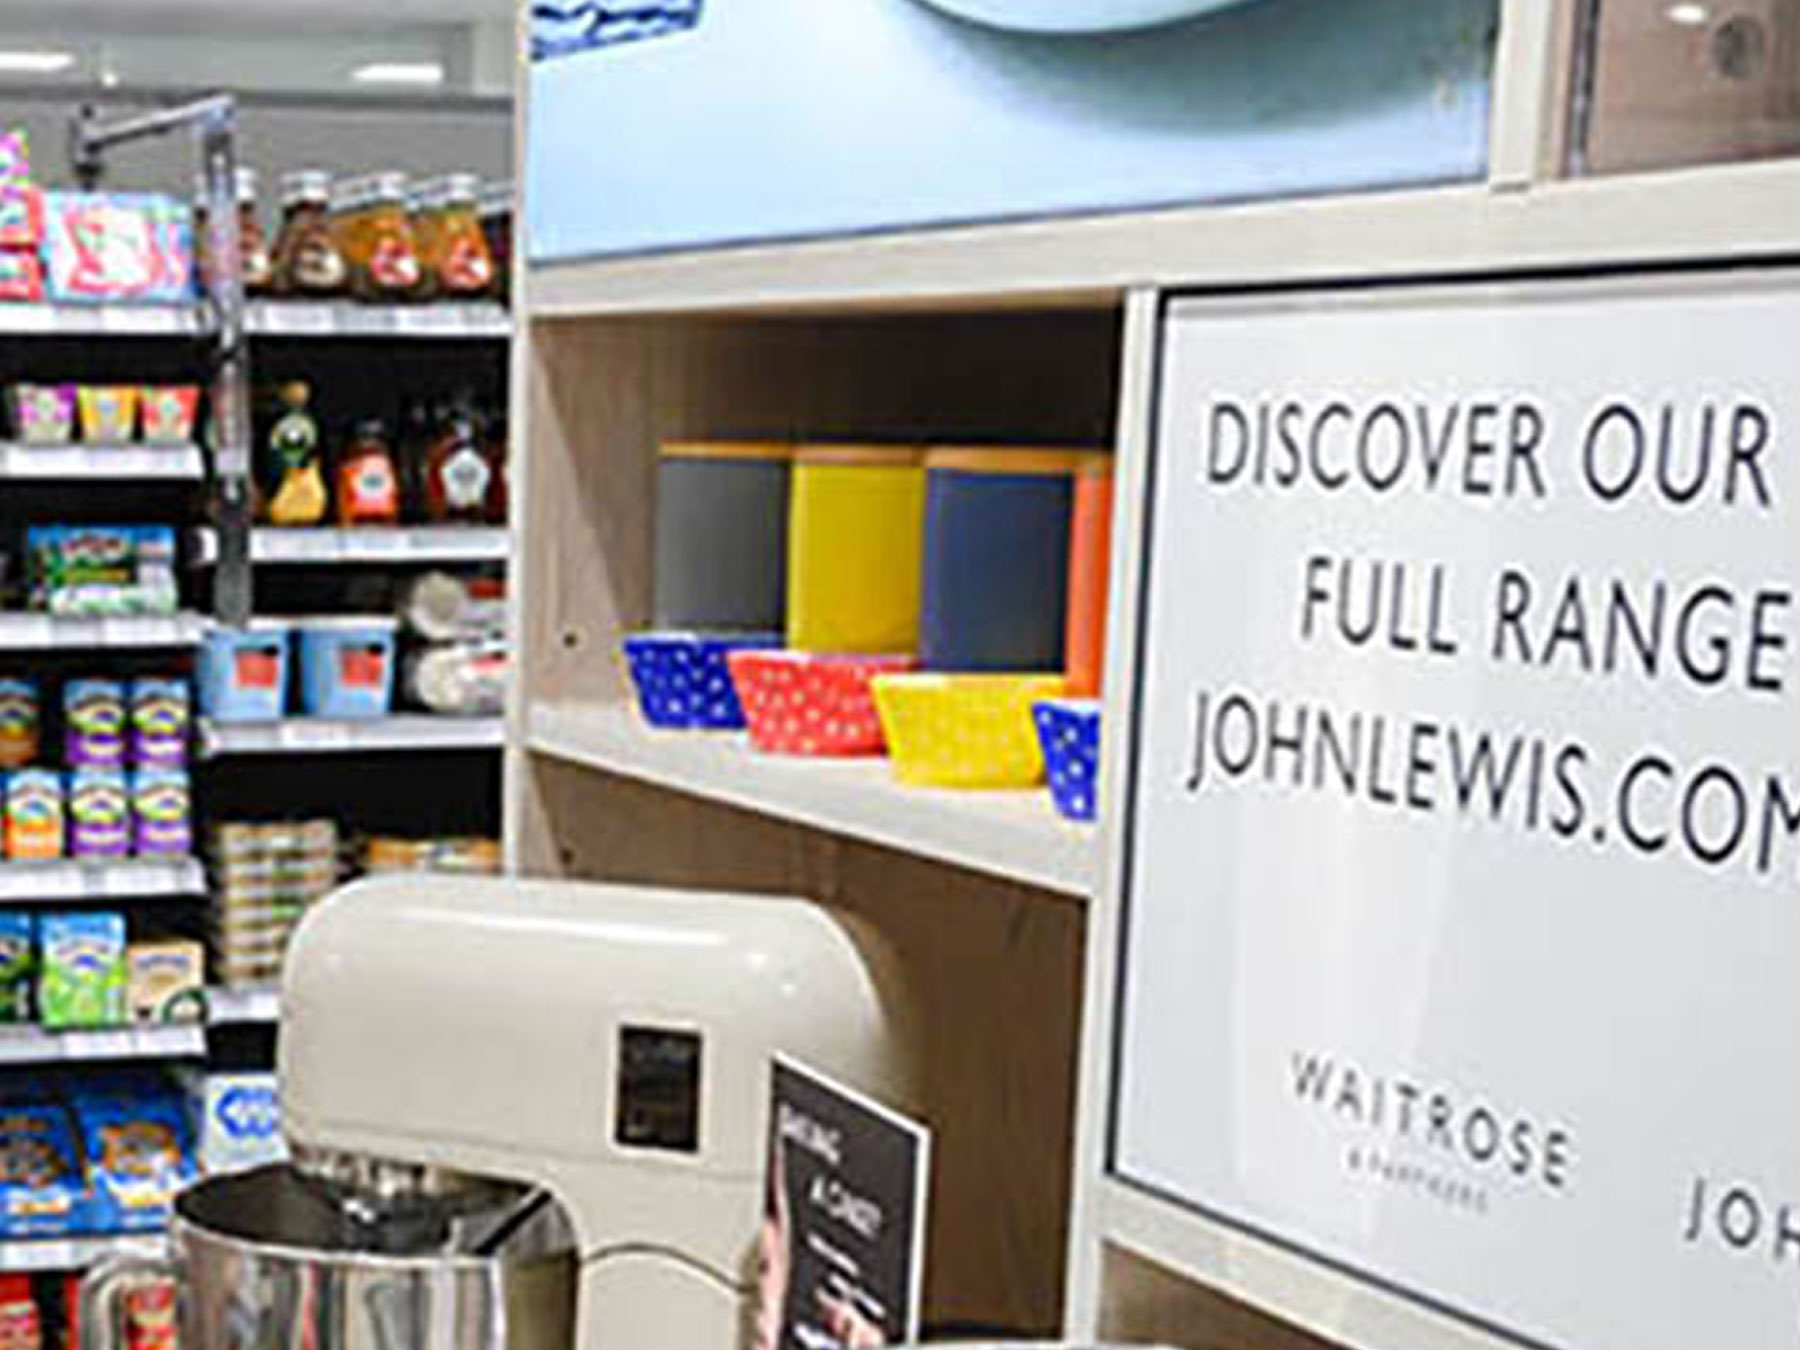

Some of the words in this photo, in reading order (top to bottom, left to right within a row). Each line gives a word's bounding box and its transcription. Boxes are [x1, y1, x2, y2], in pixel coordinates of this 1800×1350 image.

[1207, 402, 1546, 496] DISCOVER
[1583, 403, 1771, 507] OUR
[1300, 556, 1457, 654] FULL
[1492, 570, 1788, 690] RANGE
[1291, 1050, 1569, 1187] WAITROSE
